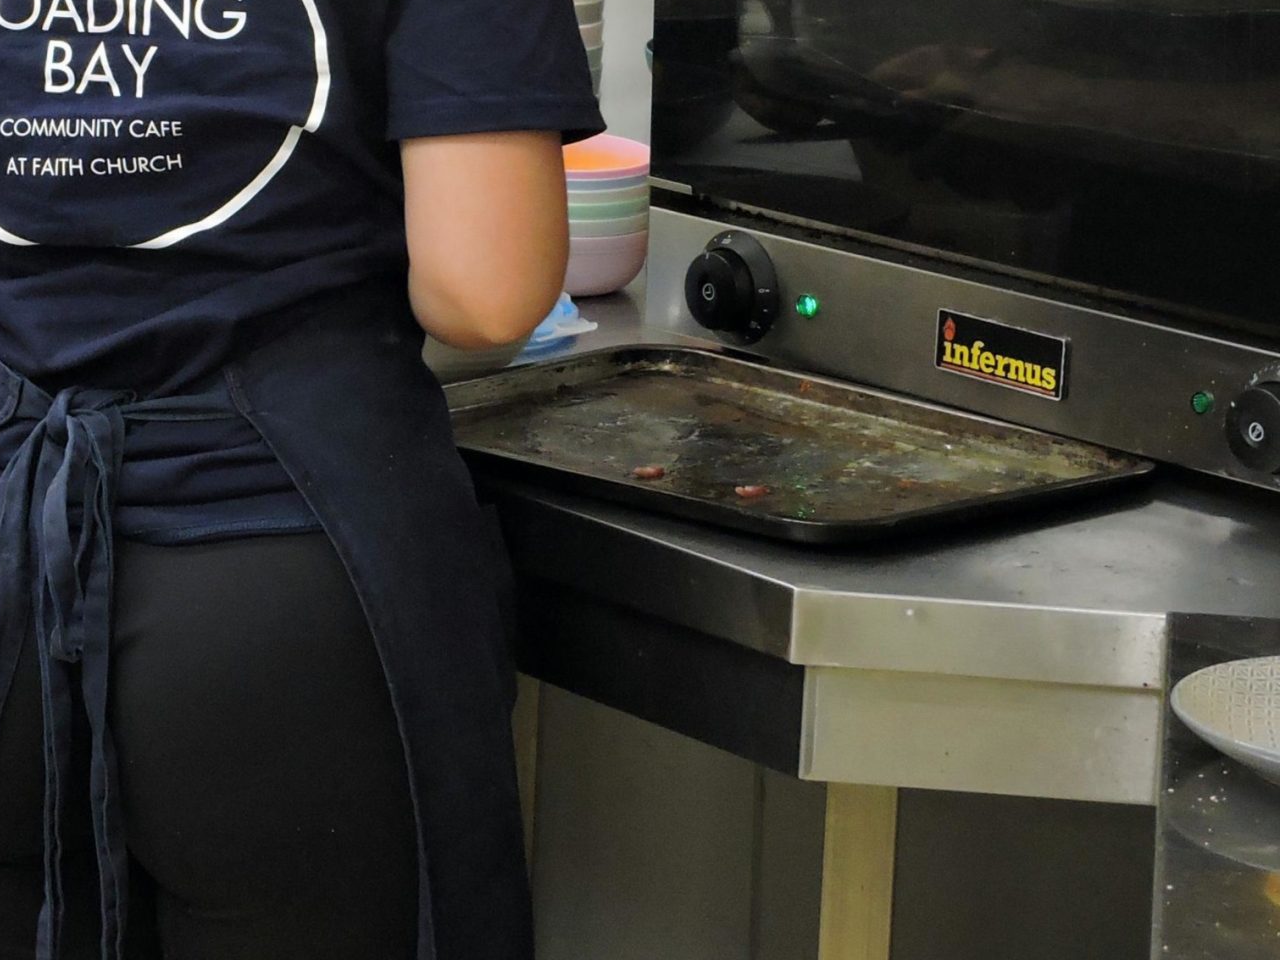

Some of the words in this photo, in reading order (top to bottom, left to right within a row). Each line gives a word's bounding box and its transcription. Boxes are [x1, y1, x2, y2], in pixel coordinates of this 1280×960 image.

[44, 41, 158, 98] BAY
[0, 118, 124, 138] COMMUNITY
[128, 120, 183, 139] CAFE
[6, 158, 29, 176] AT
[32, 158, 83, 176] FAITH
[90, 154, 183, 176] CHURCH
[942, 331, 1057, 391] infernus
